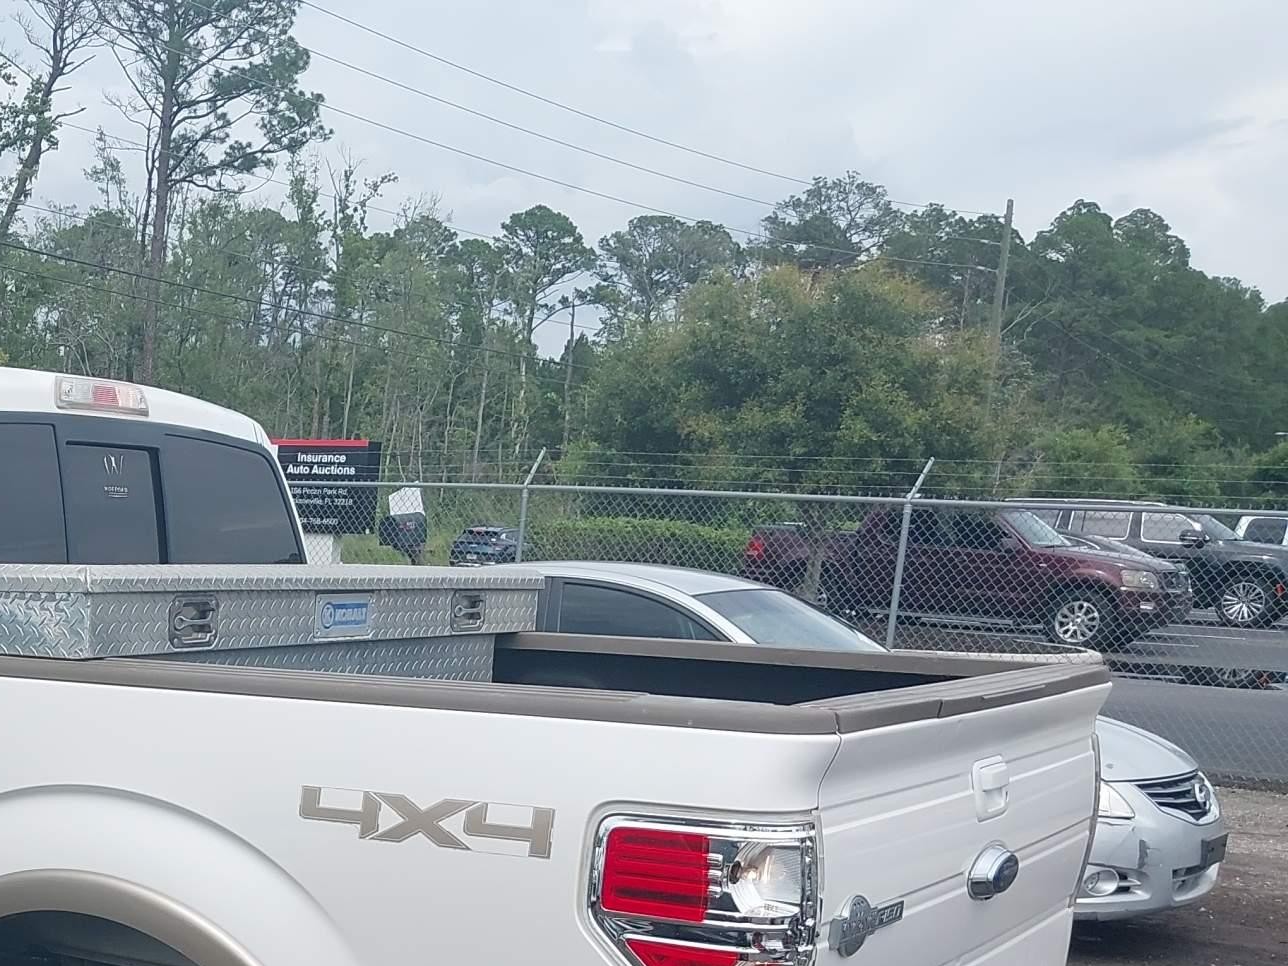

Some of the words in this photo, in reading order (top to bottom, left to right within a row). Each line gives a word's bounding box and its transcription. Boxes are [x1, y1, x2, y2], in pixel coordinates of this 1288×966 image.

[297, 452, 346, 463] Insurance
[286, 464, 310, 474] Auto
[311, 464, 355, 475] Auctions
[335, 607, 367, 621] KOBALT
